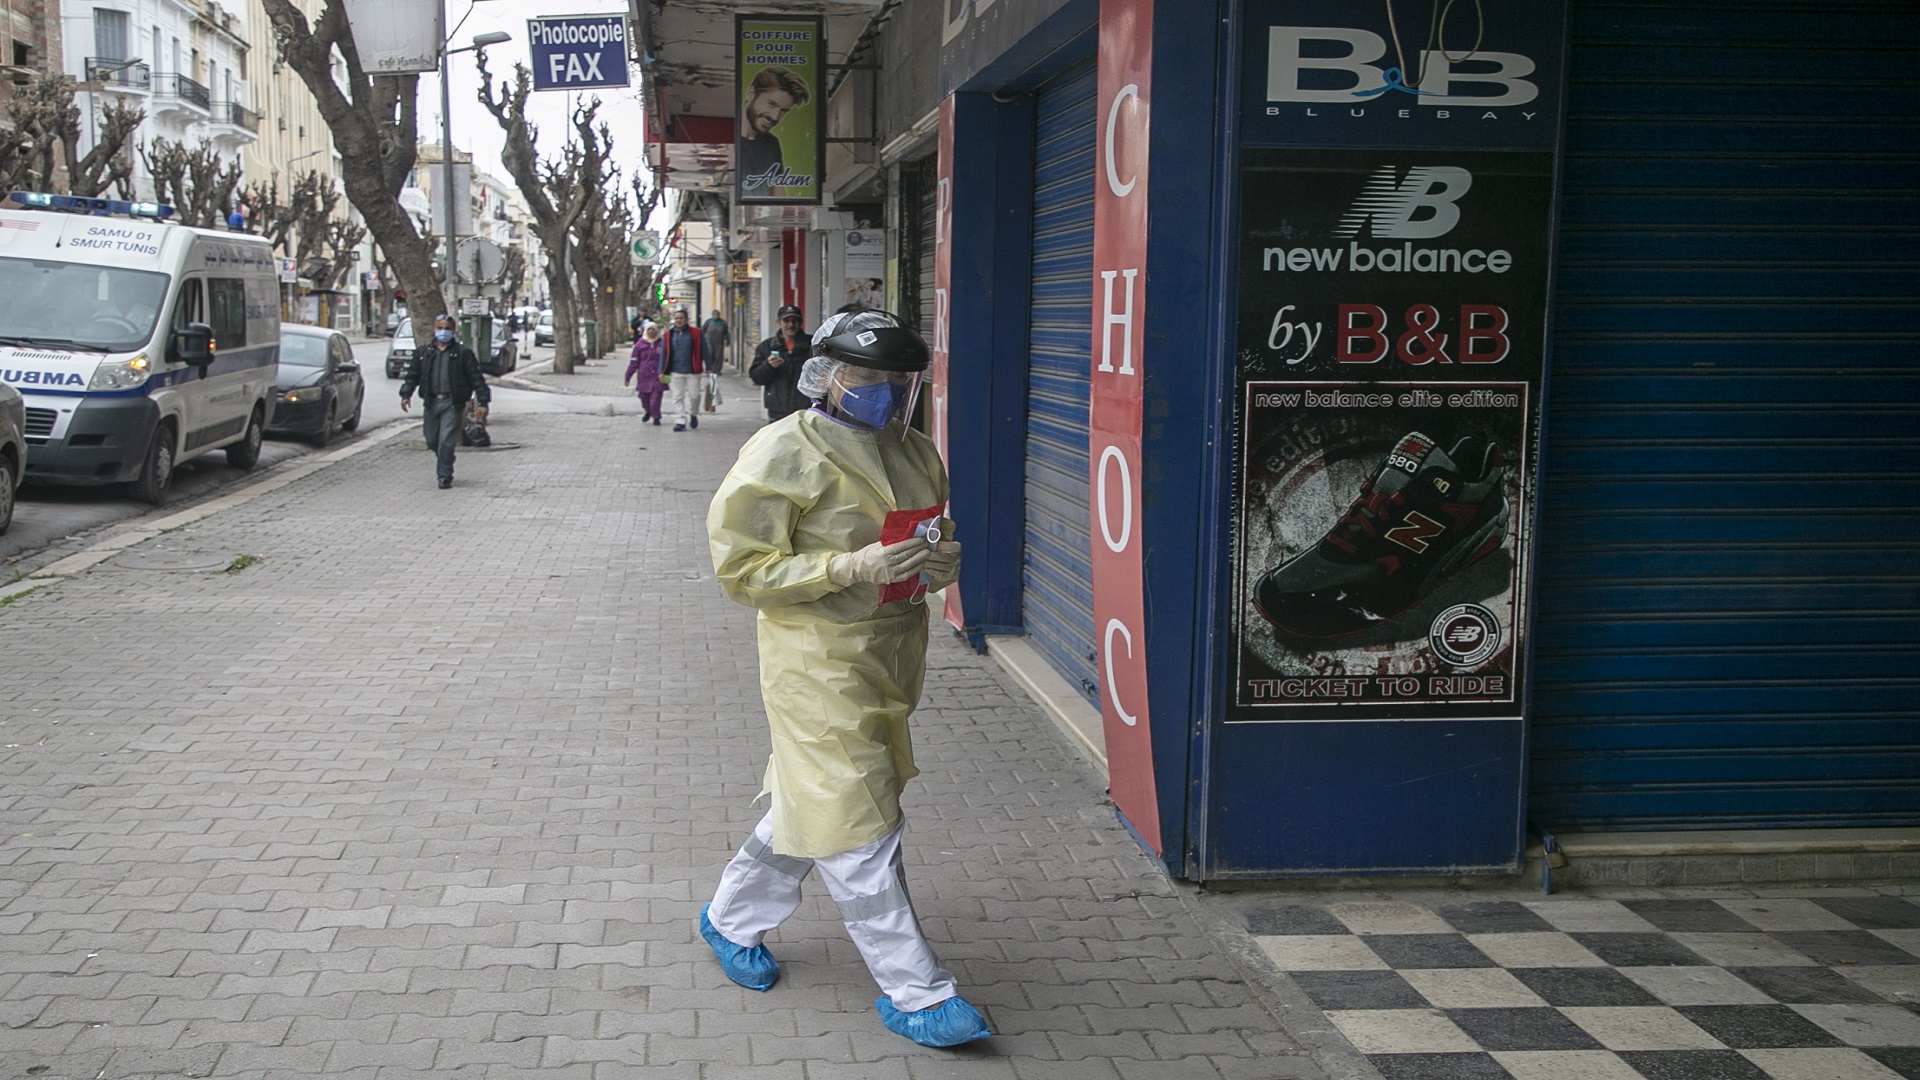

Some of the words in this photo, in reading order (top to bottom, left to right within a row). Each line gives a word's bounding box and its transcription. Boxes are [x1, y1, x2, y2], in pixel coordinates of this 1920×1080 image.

[530, 19, 623, 48] Photocopie
[742, 31, 811, 40] COIFFURE
[755, 43, 794, 52] POUR
[549, 52, 605, 83] FAX
[746, 55, 807, 65] HOMMES
[1266, 107, 1537, 121] BLUEBAY
[742, 162, 814, 190] Adam
[1330, 165, 1473, 239] NB
[88, 227, 133, 239] SAMU
[136, 232, 152, 241] 01
[70, 238, 113, 249] SMUR
[116, 242, 158, 255] TUNIS
[1263, 247, 1344, 271] new
[1350, 241, 1513, 274] balance
[1268, 304, 1323, 365] by
[1337, 303, 1511, 366] B&B
[1097, 83, 1138, 727] CHOC
[1255, 392, 1301, 408] new
[1304, 390, 1394, 408] balance
[1398, 390, 1442, 408] elite
[1447, 390, 1519, 408] edition
[1248, 678, 1369, 698] TICKET
[1376, 677, 1421, 696] TO
[1428, 675, 1504, 695] RIDE
